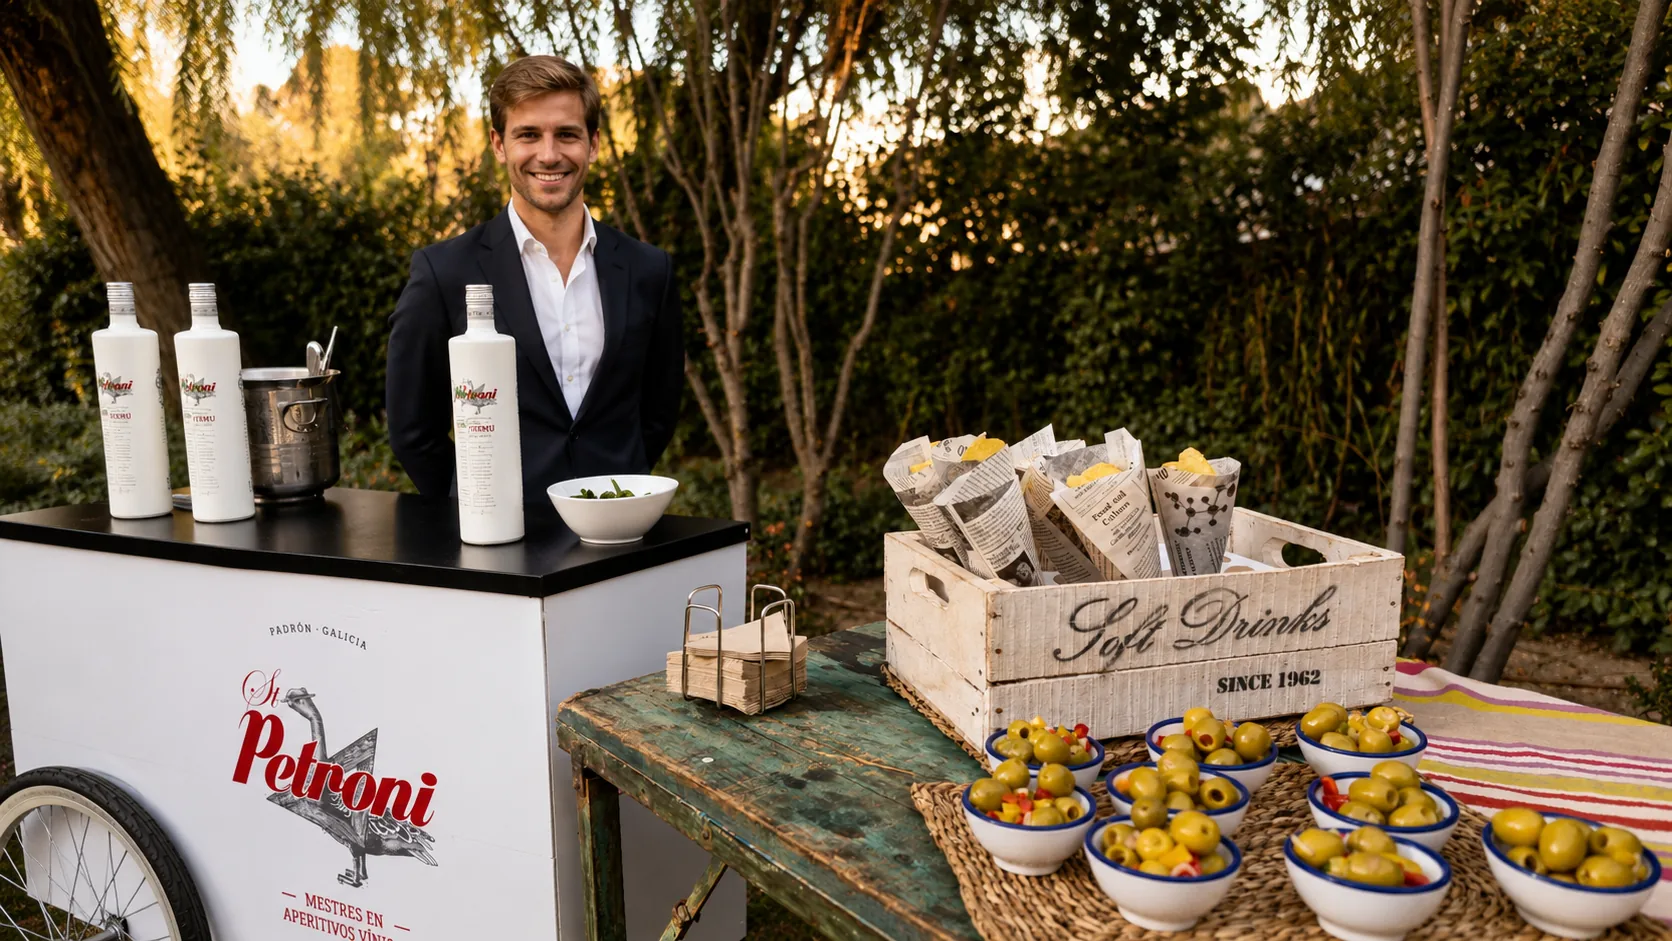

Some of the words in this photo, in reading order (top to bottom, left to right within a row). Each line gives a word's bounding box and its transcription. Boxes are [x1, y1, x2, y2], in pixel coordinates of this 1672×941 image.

[269, 621, 312, 636] PADRÓN
[321, 626, 367, 651] GALICIA
[1053, 597, 1169, 669] Soft
[1172, 584, 1338, 650] Drinks
[241, 668, 282, 711] St
[1216, 674, 1273, 694] SINCE
[1278, 669, 1321, 688] 1962
[232, 709, 438, 828] Petroni
[283, 907, 356, 941] APERITIVOS
[305, 892, 363, 922] MESTRES
[366, 910, 383, 929] EN
